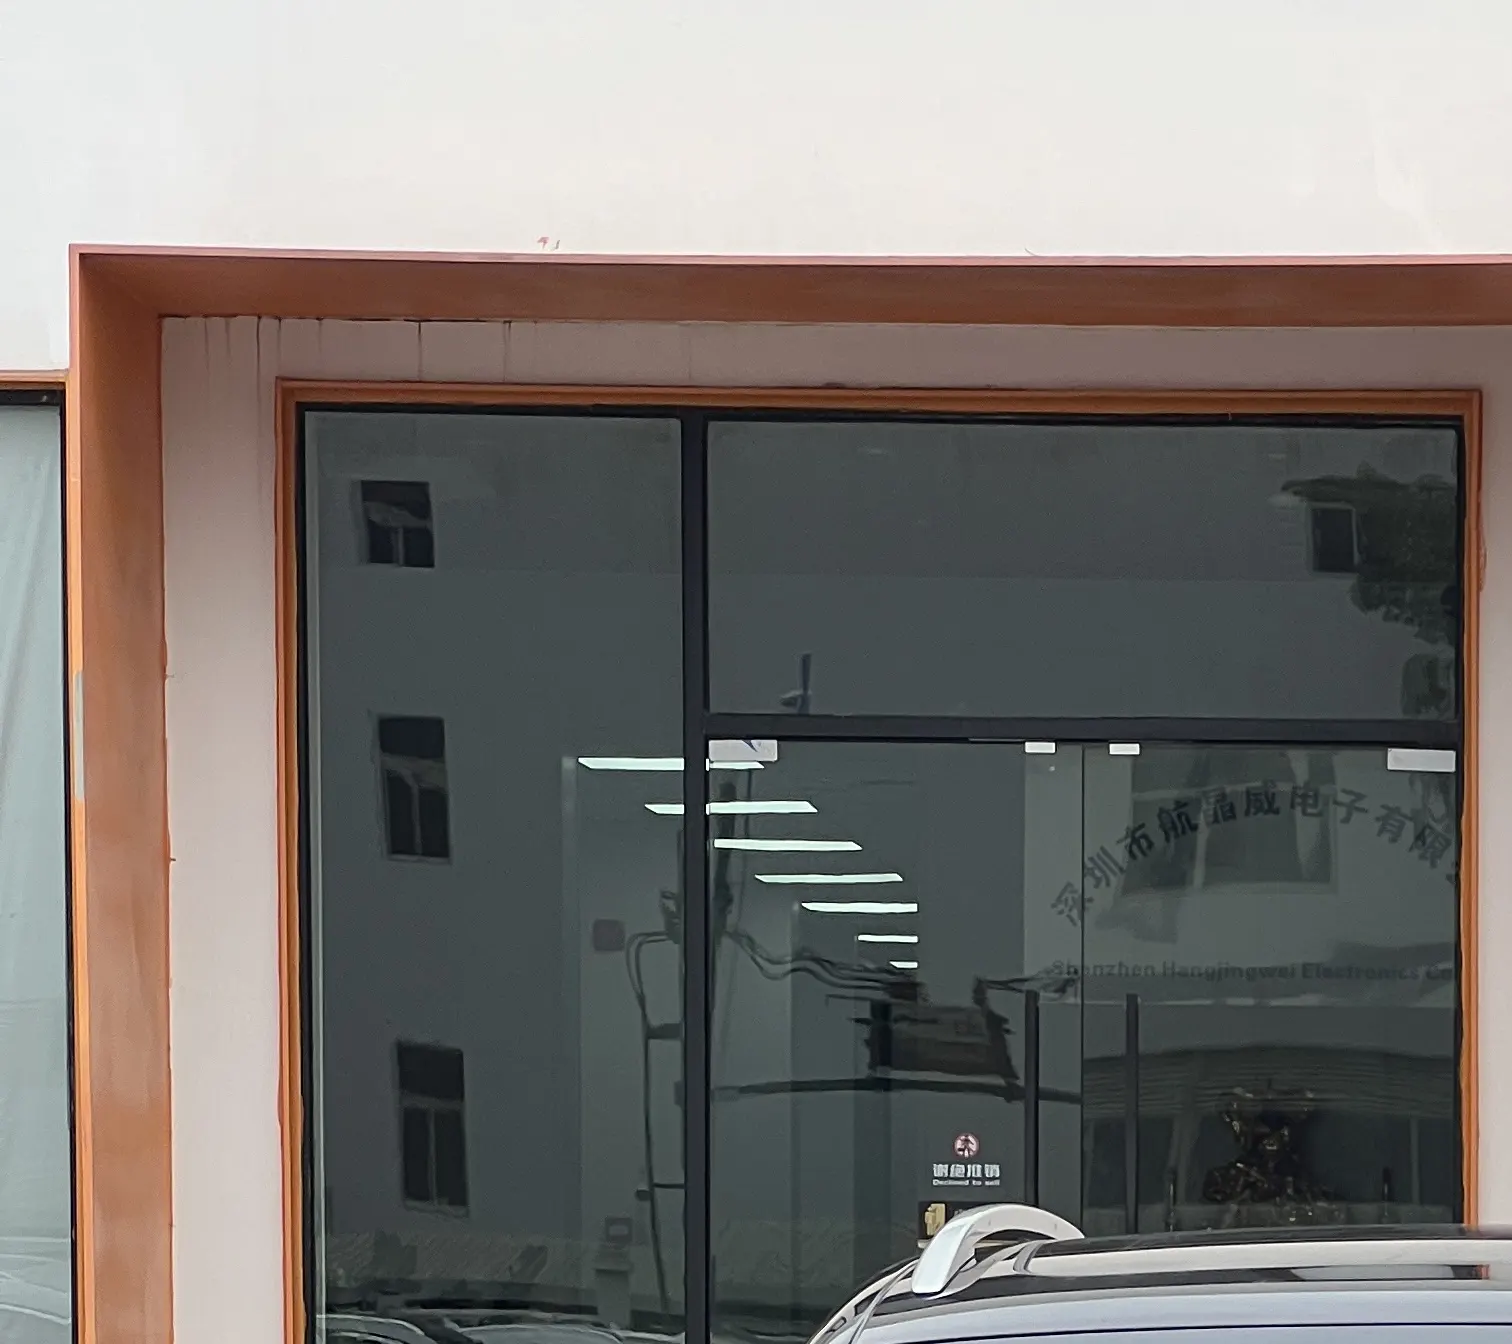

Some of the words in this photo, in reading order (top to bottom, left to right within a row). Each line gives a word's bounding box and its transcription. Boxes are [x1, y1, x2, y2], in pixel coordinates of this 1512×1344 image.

[1051, 779, 1457, 927] 深圳市航晶威电子有限
